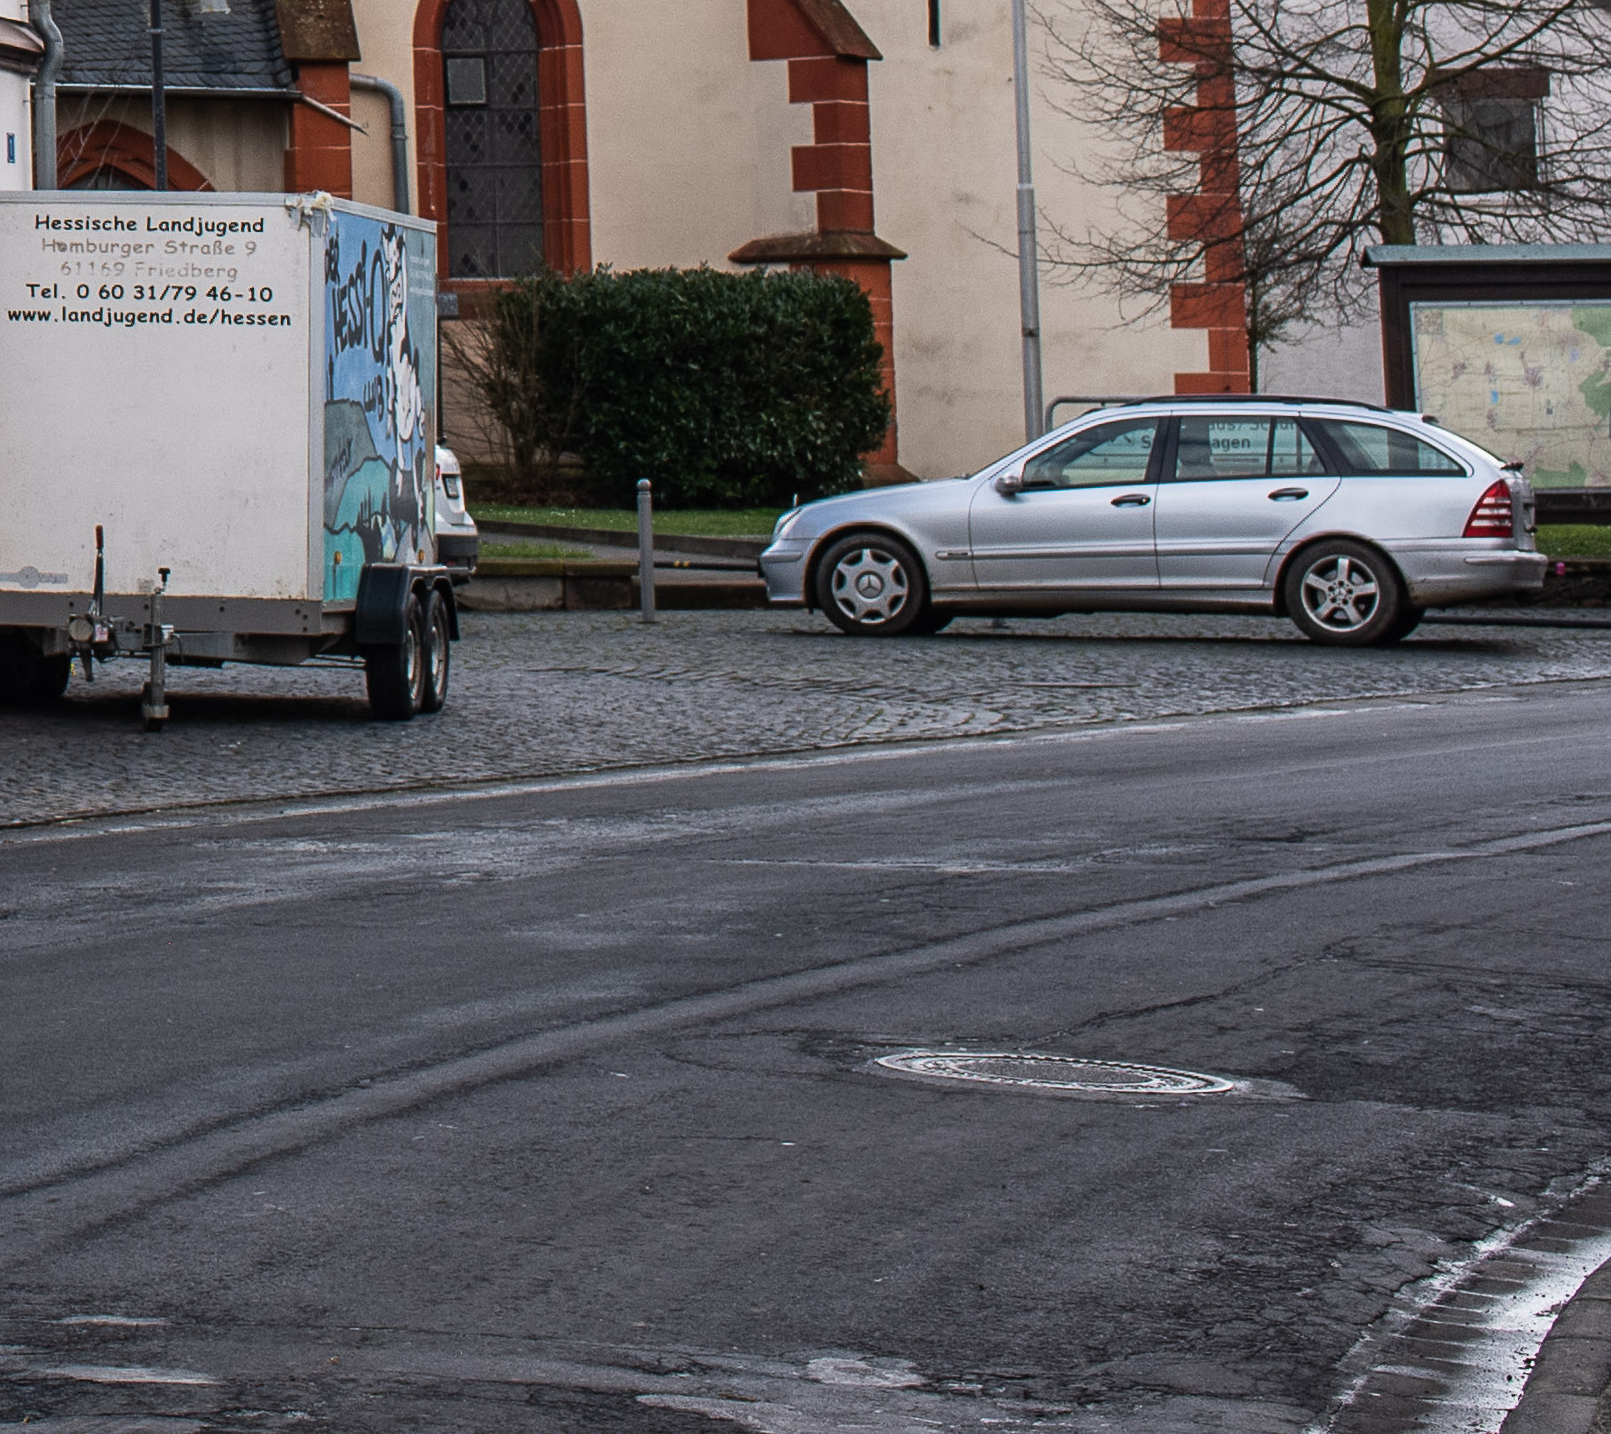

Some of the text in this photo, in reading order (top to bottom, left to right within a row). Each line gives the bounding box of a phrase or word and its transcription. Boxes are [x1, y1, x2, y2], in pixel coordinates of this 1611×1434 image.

[35, 215, 265, 237] Hessische Landjugend
[164, 240, 236, 256] Straße
[246, 241, 257, 259] 9
[60, 261, 239, 282] 61169 Friedberg
[26, 284, 274, 302] Tel. 0 60 31/79 46-10
[7, 305, 292, 327] www.landjugend.de/hessen
